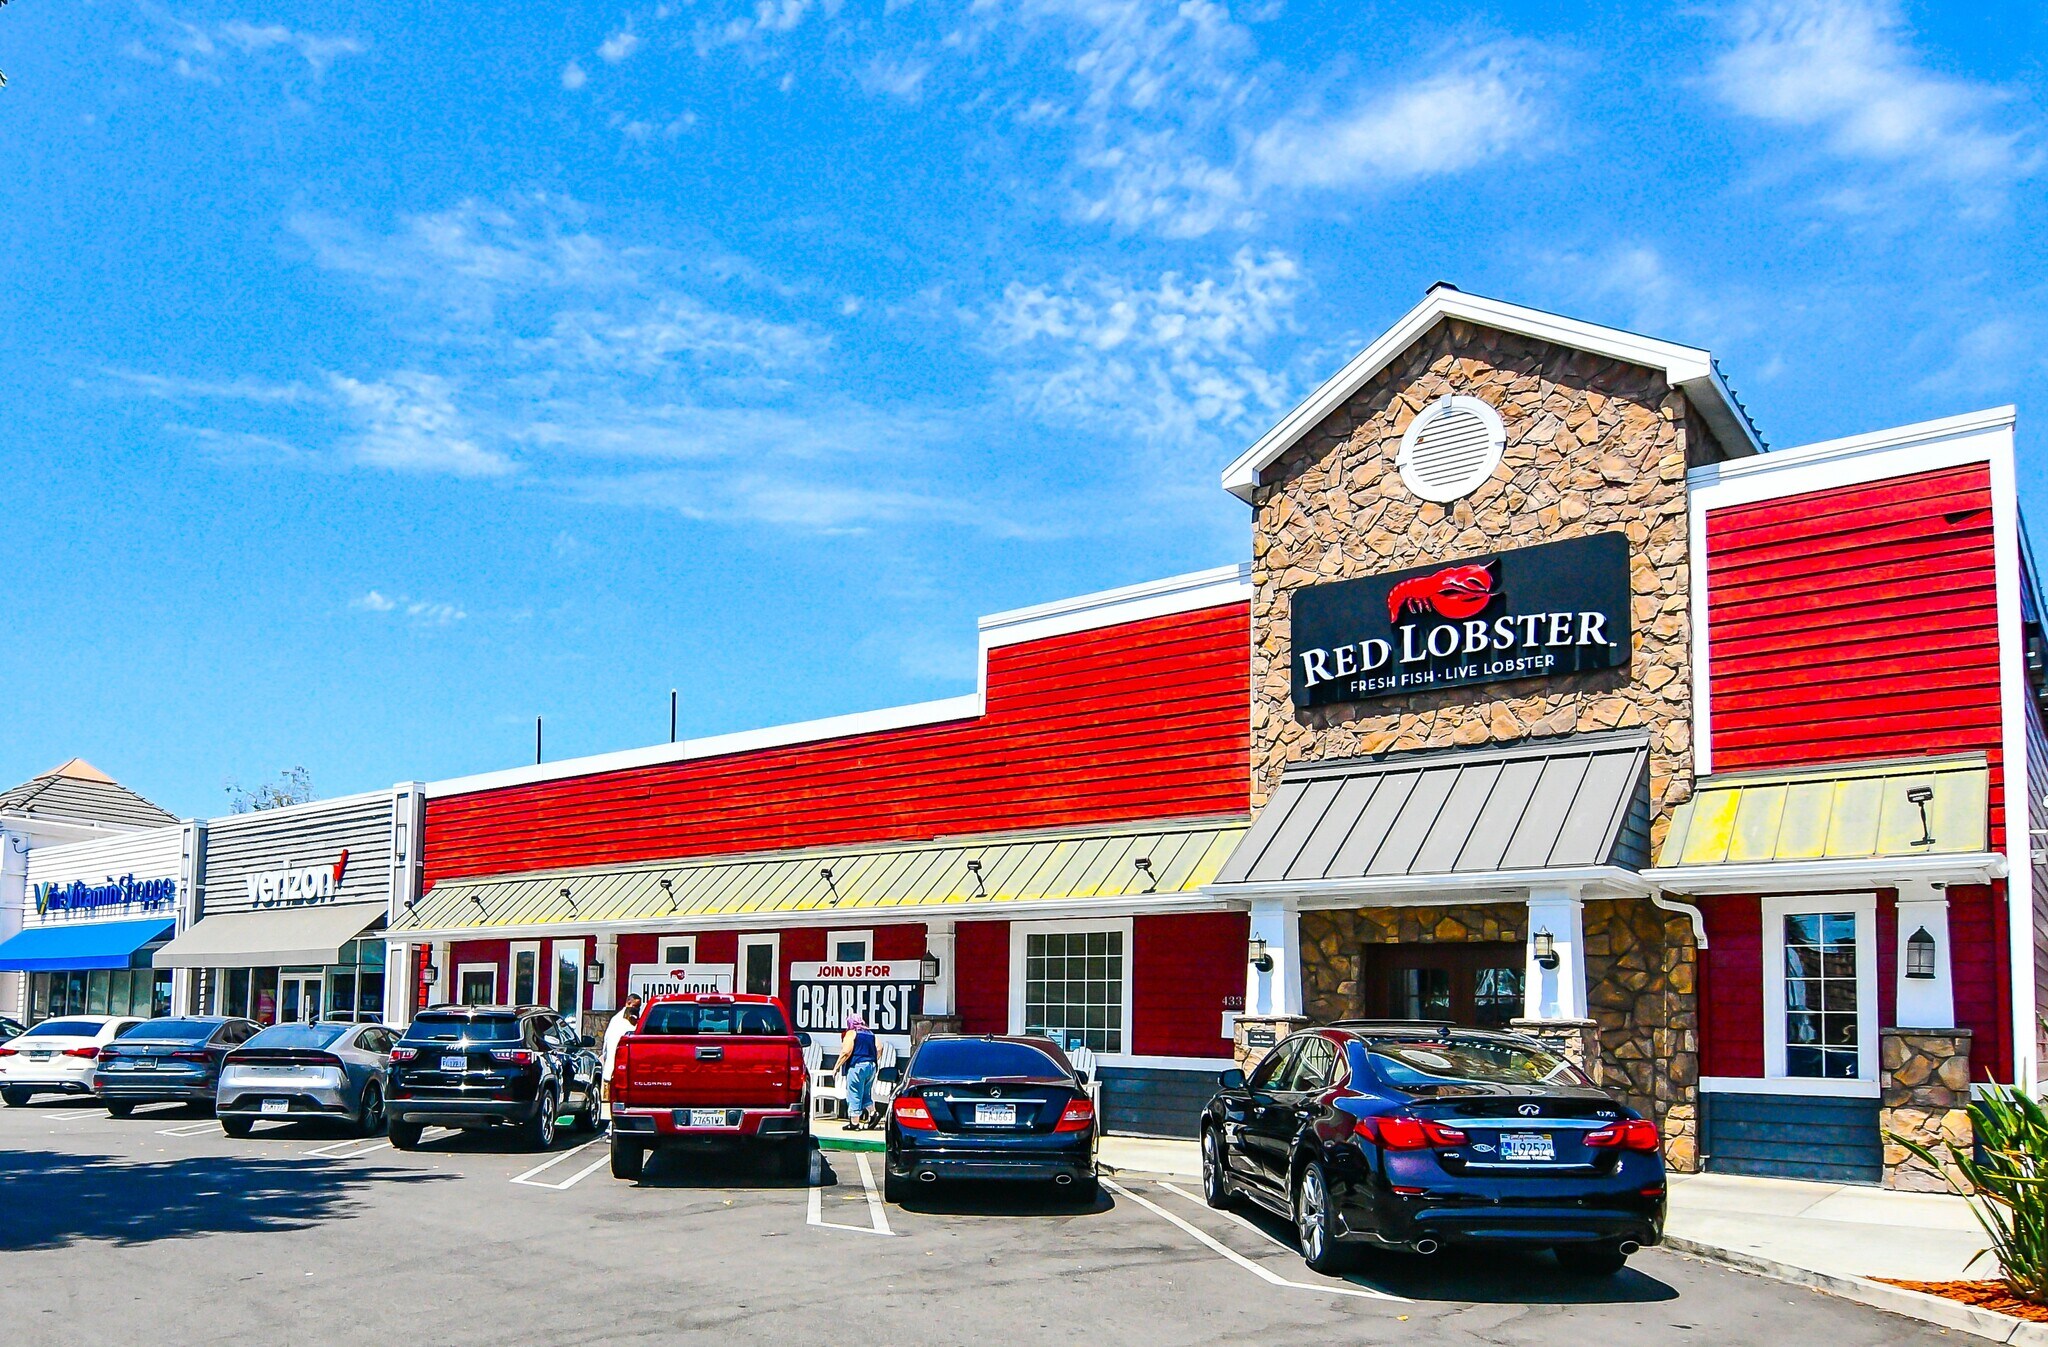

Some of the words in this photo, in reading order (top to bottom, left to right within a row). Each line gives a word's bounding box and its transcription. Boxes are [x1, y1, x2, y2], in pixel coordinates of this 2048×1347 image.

[1299, 638, 1390, 689] RED
[1399, 611, 1609, 663] LOBSTER
[1350, 675, 1396, 692] FRESH
[1401, 672, 1434, 687] FISH
[1445, 664, 1478, 680] LIVE
[1484, 654, 1555, 675] LOBSTER
[119, 873, 175, 910] Shoppe
[245, 860, 335, 902] verizon
[817, 965, 844, 978] JOIN
[847, 965, 862, 978] US
[865, 965, 891, 977] FOR
[1221, 996, 1246, 1006] 433
